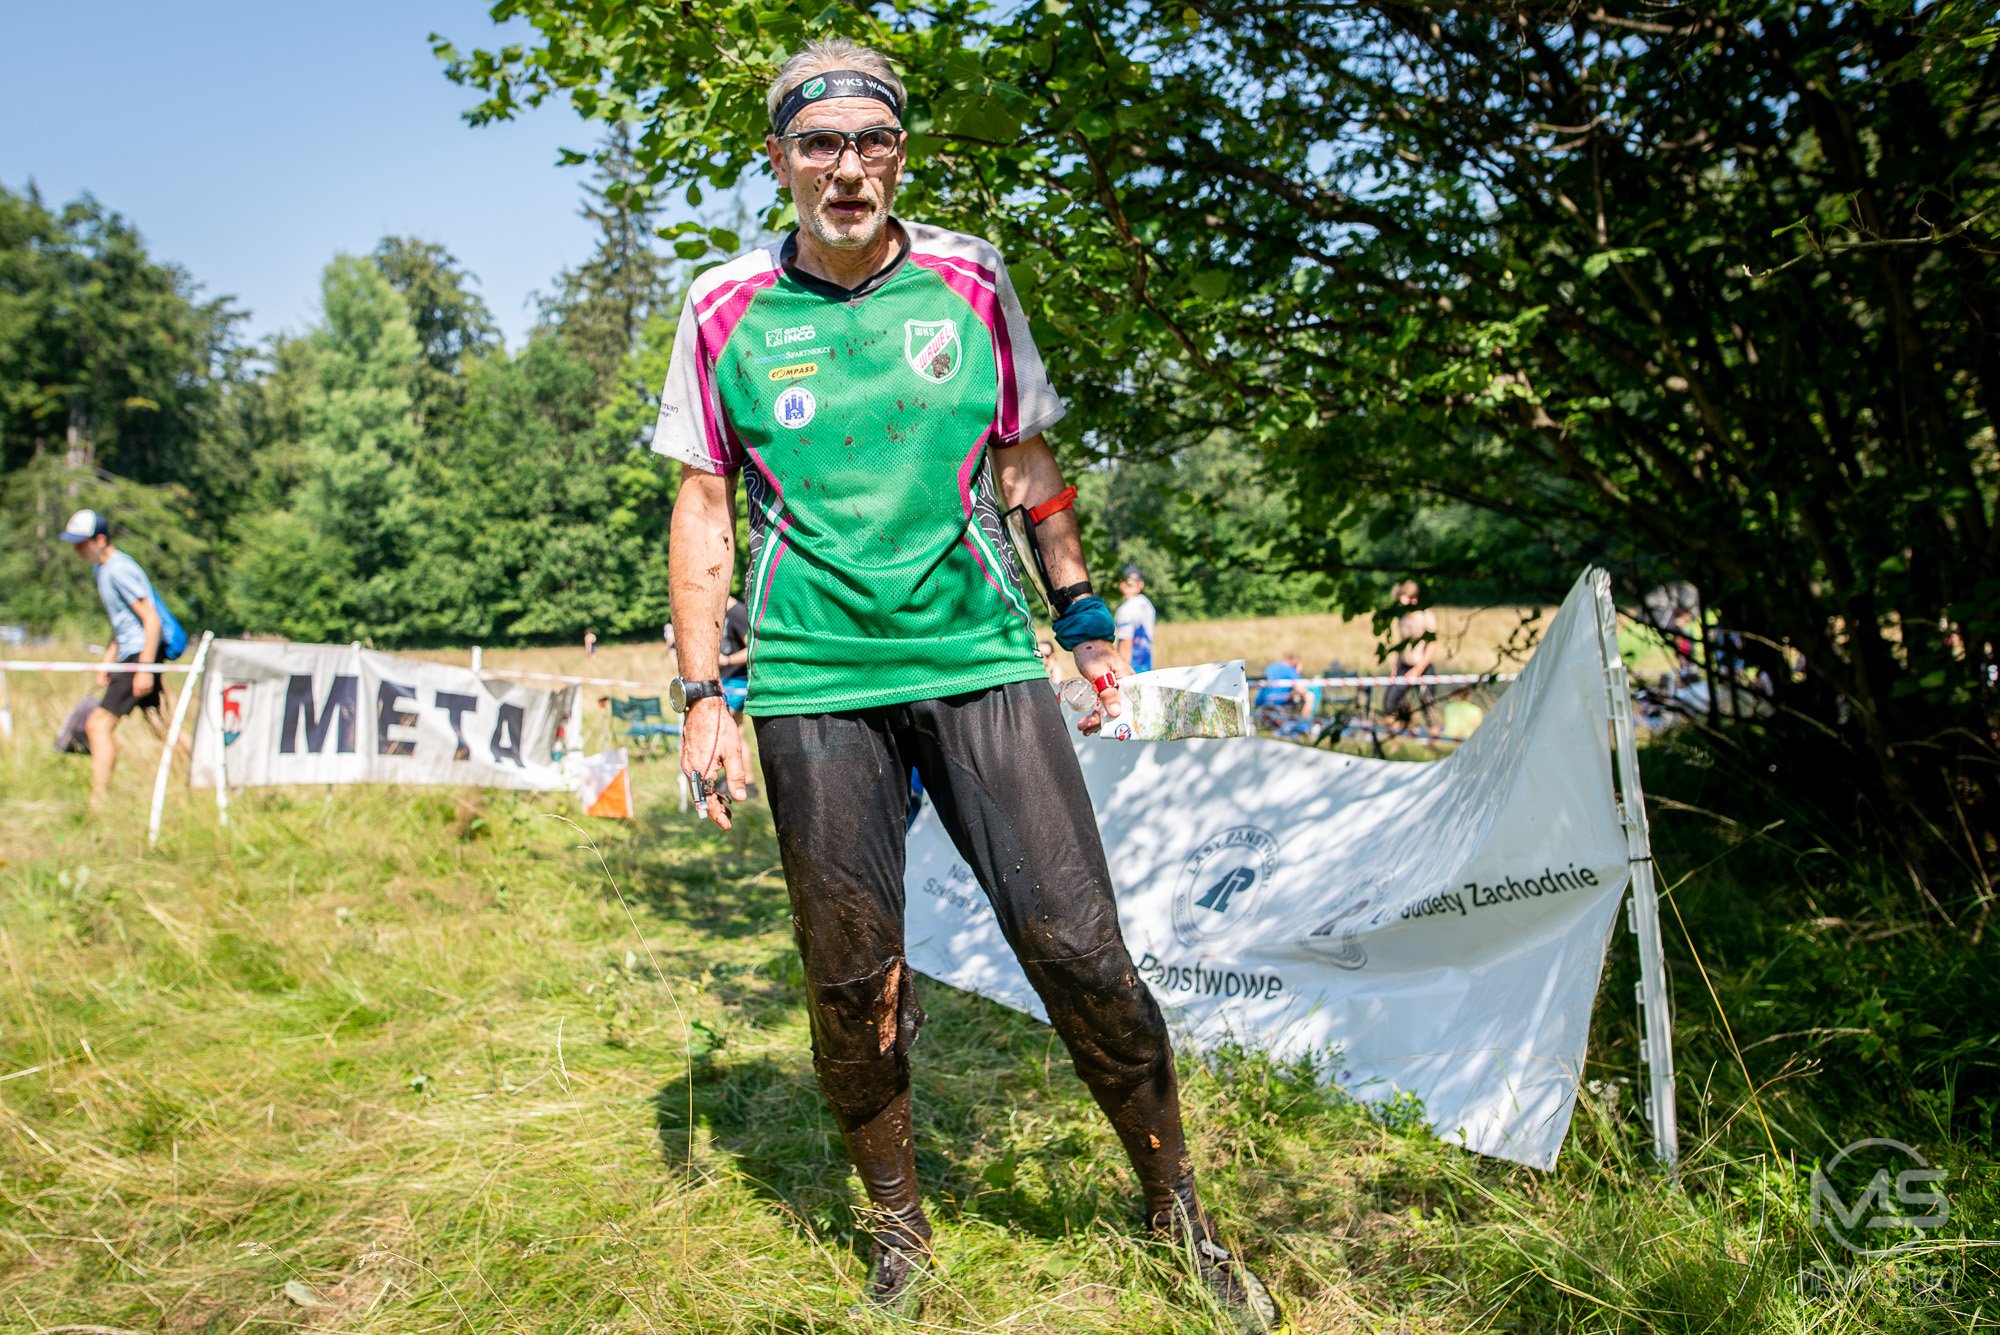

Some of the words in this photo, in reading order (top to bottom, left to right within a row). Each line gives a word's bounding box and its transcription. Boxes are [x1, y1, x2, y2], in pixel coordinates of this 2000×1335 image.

[833, 79, 863, 87] WKS
[784, 330, 816, 344] INCO
[914, 327, 935, 336] WKS
[919, 327, 951, 369] WAWEL
[771, 365, 815, 378] COMPASS
[280, 675, 525, 768] META
[1464, 862, 1600, 908] Zachodnie
